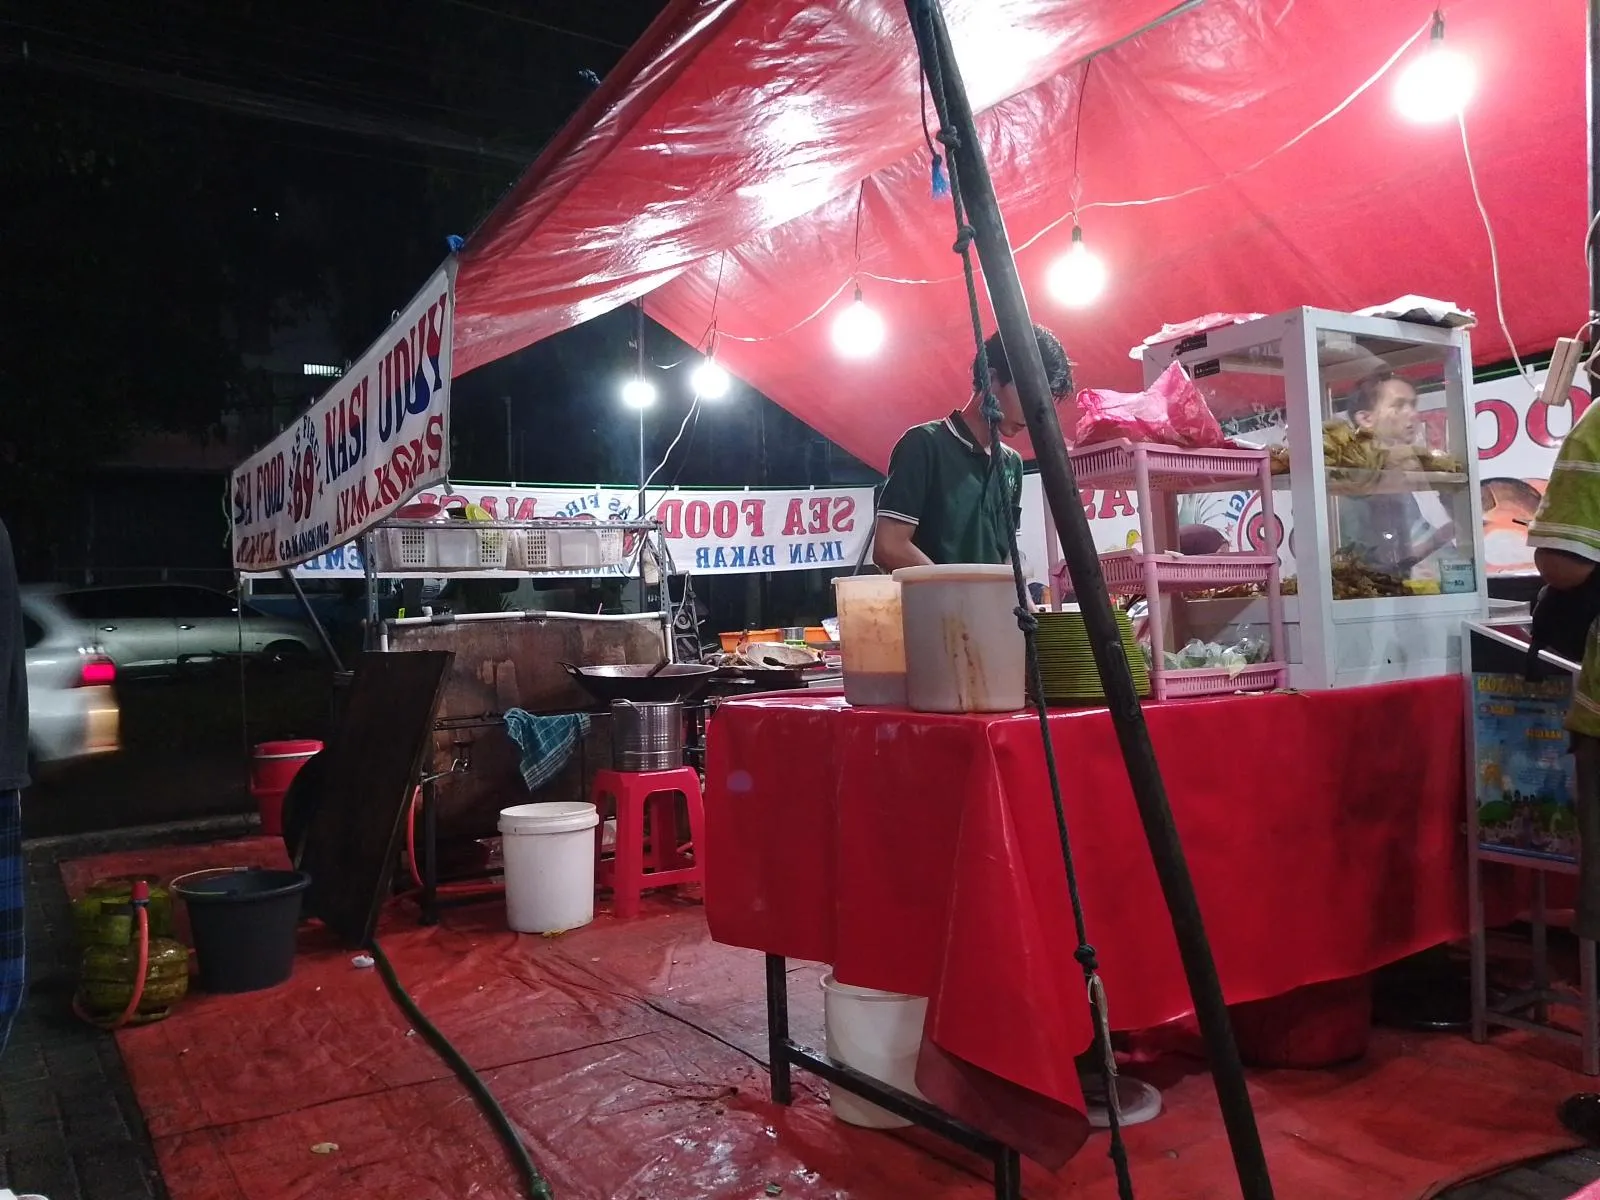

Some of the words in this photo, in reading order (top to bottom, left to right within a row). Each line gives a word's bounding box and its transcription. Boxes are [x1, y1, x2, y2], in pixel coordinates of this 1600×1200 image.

[324, 375, 369, 485] NASI
[257, 451, 285, 525] FOOD
[293, 444, 315, 524] 69
